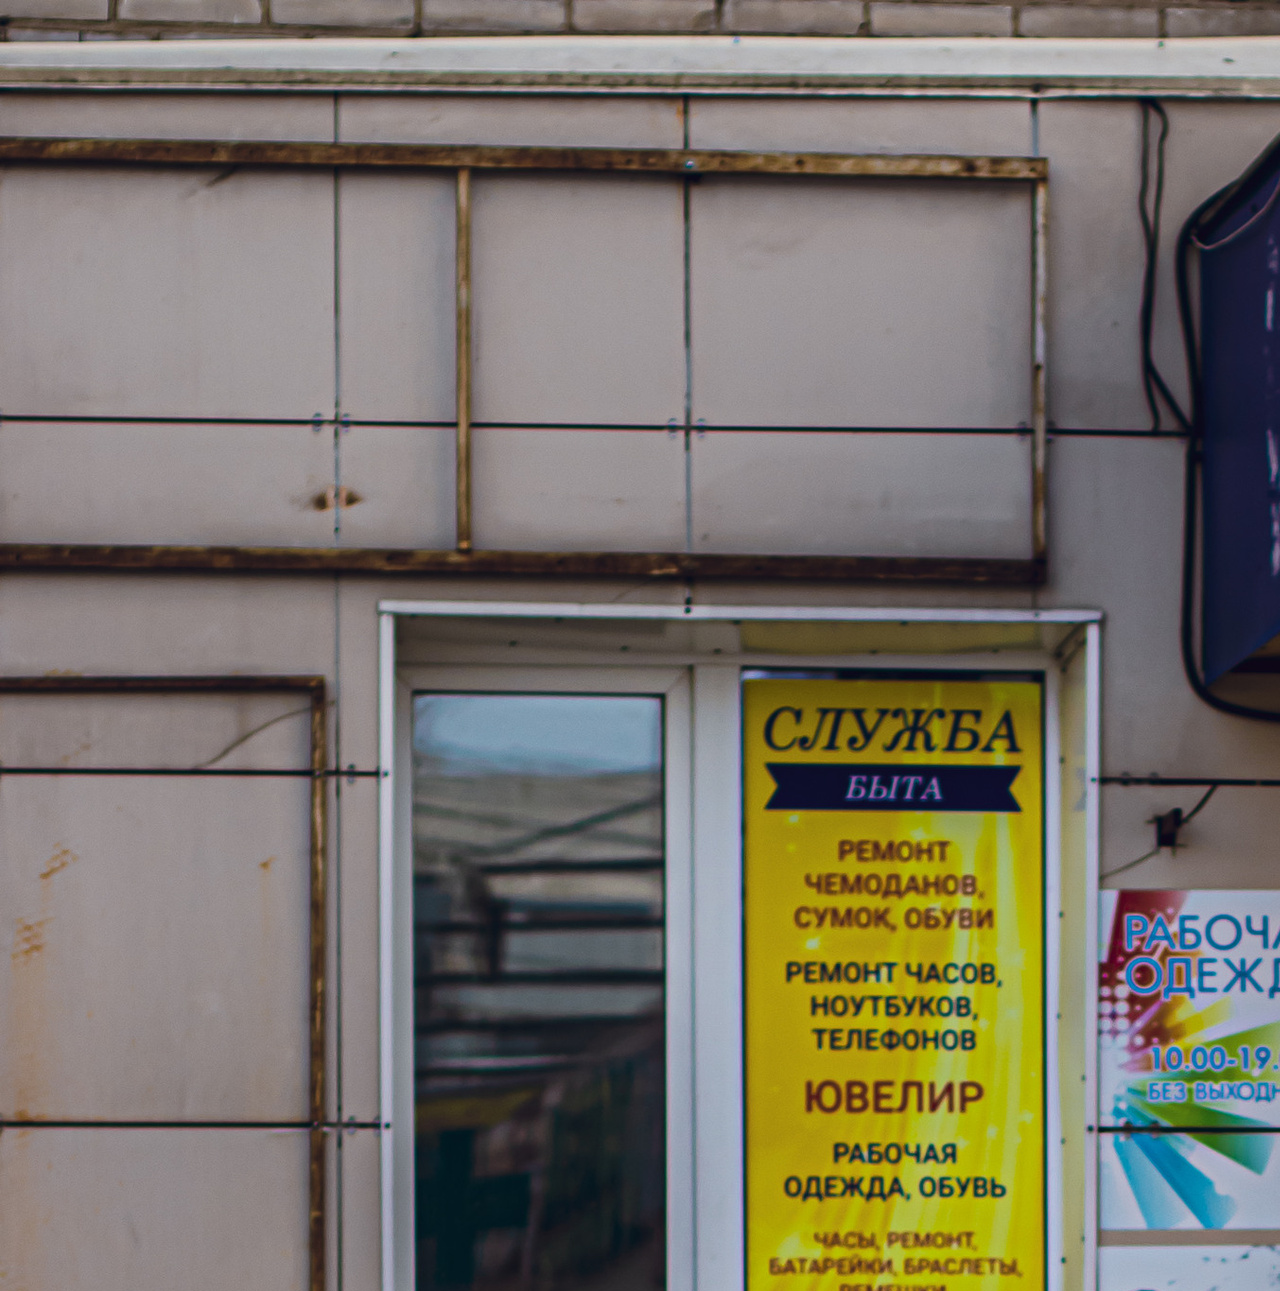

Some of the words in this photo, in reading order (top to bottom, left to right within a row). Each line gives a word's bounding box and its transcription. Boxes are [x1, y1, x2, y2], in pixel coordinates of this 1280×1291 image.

[763, 706, 1022, 753] СЛУЖБА
[845, 775, 943, 801] БЫТА
[838, 840, 950, 862] РЕМОНТ
[804, 873, 985, 899] ЧЕМОДАНОВ,
[793, 906, 897, 932] СУМОК,
[903, 907, 995, 930] ОБУВИ
[785, 961, 898, 984] РЕМОНТ
[904, 962, 1003, 988] ЧАСОВ,
[810, 995, 978, 1021] НОУТБУКОВ,
[811, 1028, 977, 1051] ТЕЛЕФОНОВ
[804, 1080, 985, 1114] ЮВЕЛИР
[1148, 1081, 1187, 1101] БЕЗ
[832, 1142, 958, 1164] РАБОЧАЯ
[783, 1176, 911, 1202] ОДЕЖДА,
[918, 1176, 1007, 1199] ОБУВЬ
